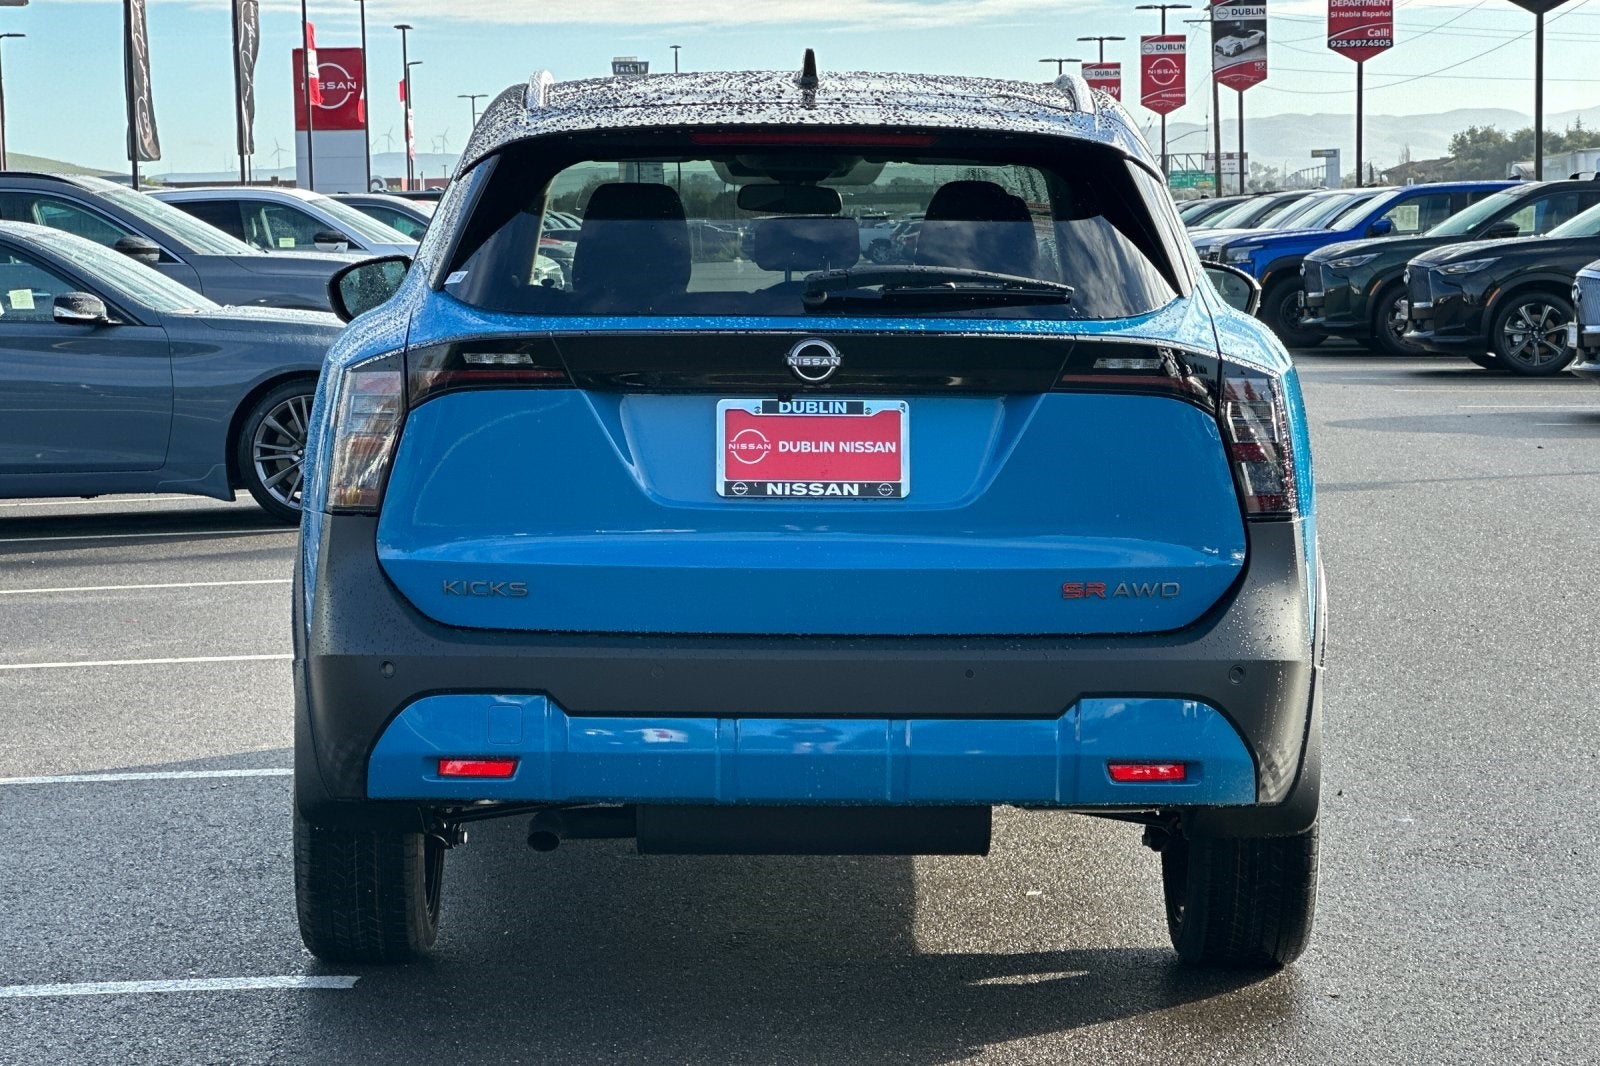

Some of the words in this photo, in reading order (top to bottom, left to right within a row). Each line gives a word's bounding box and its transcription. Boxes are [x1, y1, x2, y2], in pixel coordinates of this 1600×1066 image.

[1231, 8, 1266, 16] DUBLIN
[1339, 10, 1361, 18] Habla
[1367, 28, 1390, 37] Call!
[1155, 43, 1186, 51] DUBLIN
[1330, 40, 1391, 48] 925.997.4505
[301, 81, 357, 90] SSAN
[787, 358, 841, 366] NISSAN
[778, 401, 847, 414] DUBLIN
[778, 440, 834, 453] DUBLIN
[839, 441, 896, 453] NISSAN
[766, 482, 859, 496] NISSAN
[443, 579, 528, 597] KICKS
[1062, 581, 1106, 599] SR
[1113, 582, 1181, 598] AWD
